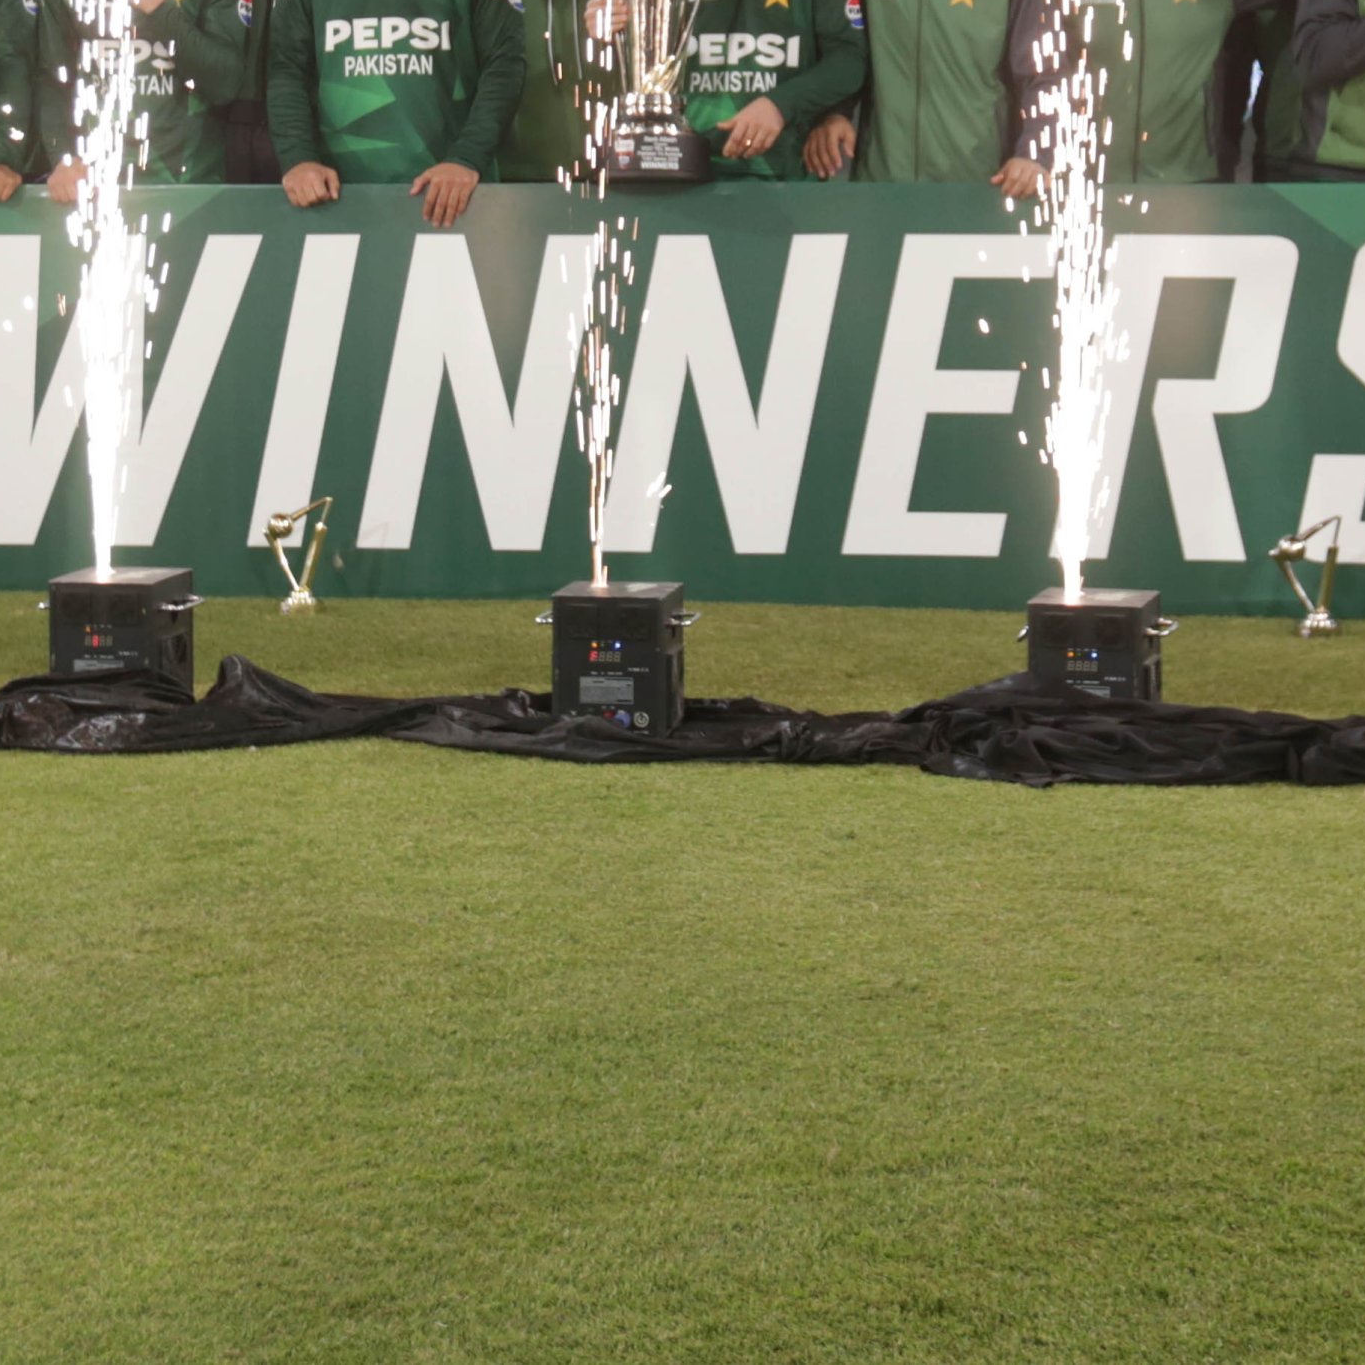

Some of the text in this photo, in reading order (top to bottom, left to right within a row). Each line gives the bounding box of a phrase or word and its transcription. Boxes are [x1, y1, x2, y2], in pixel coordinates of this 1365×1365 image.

[325, 16, 452, 52] PEPSI
[344, 54, 433, 77] PAKISTAN
[690, 70, 777, 93] PAKISTAN
